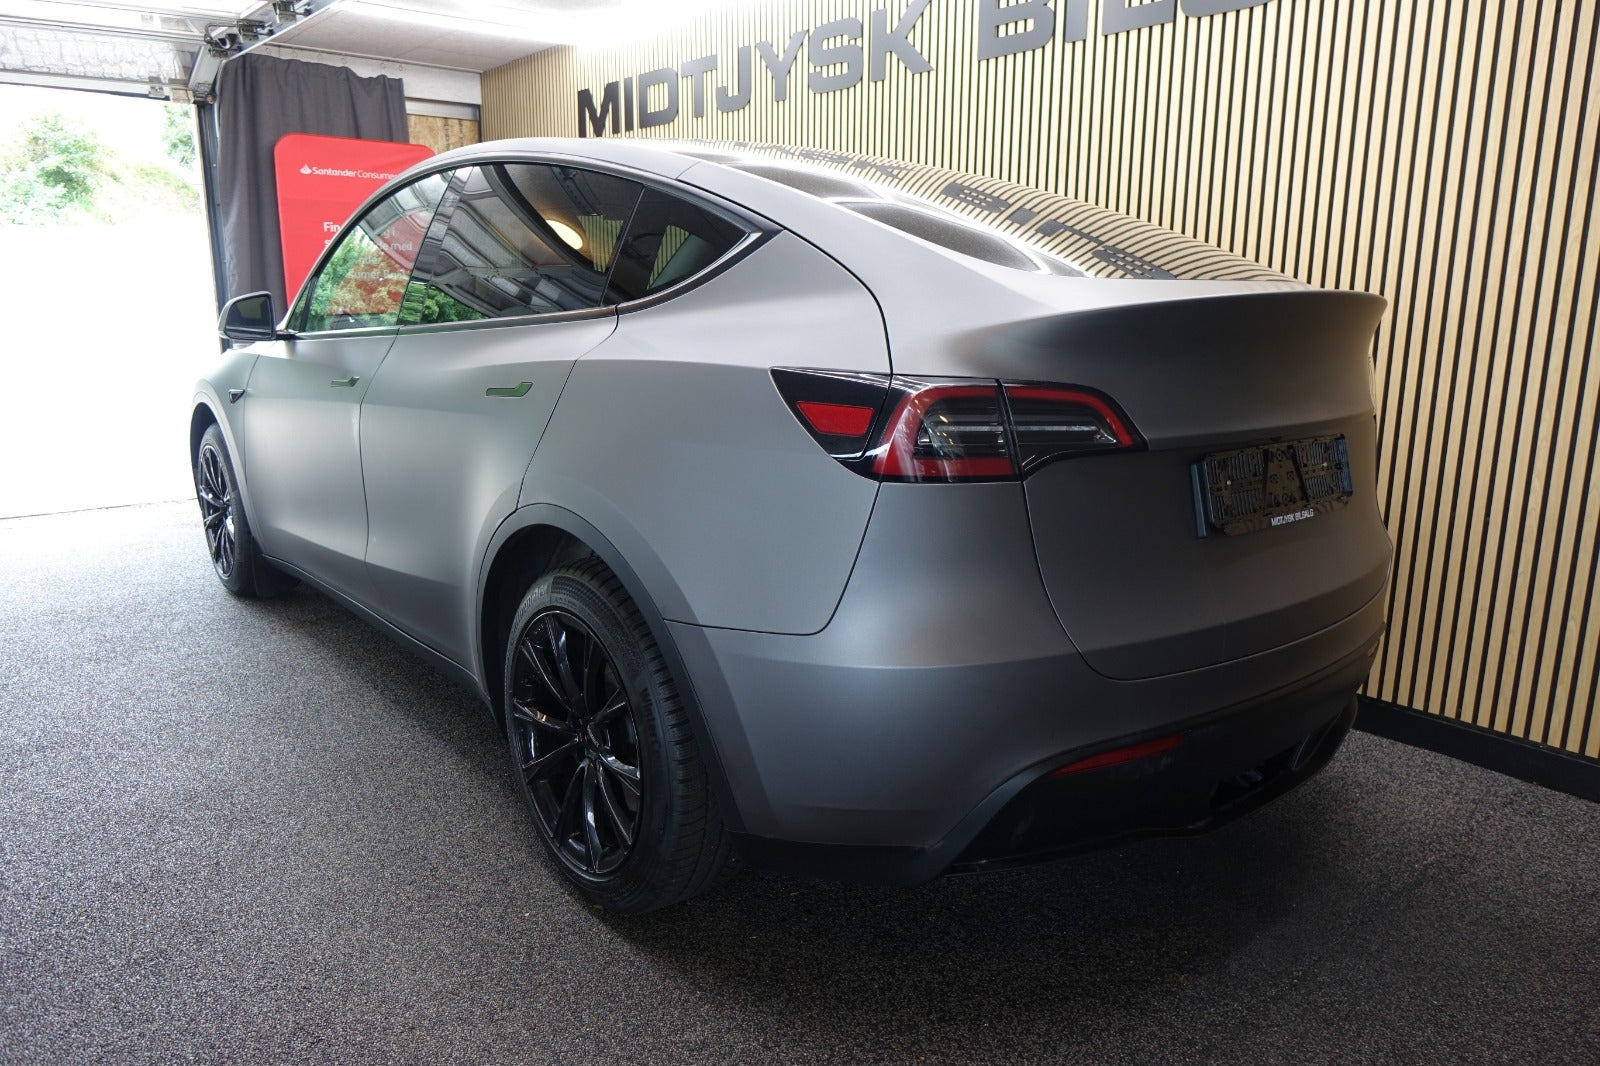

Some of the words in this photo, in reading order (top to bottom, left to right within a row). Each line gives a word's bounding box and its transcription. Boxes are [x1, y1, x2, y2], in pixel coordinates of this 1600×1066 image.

[577, 0, 934, 138] MIDTJYSK
[312, 166, 356, 177] Santander
[357, 170, 397, 180] Consume
